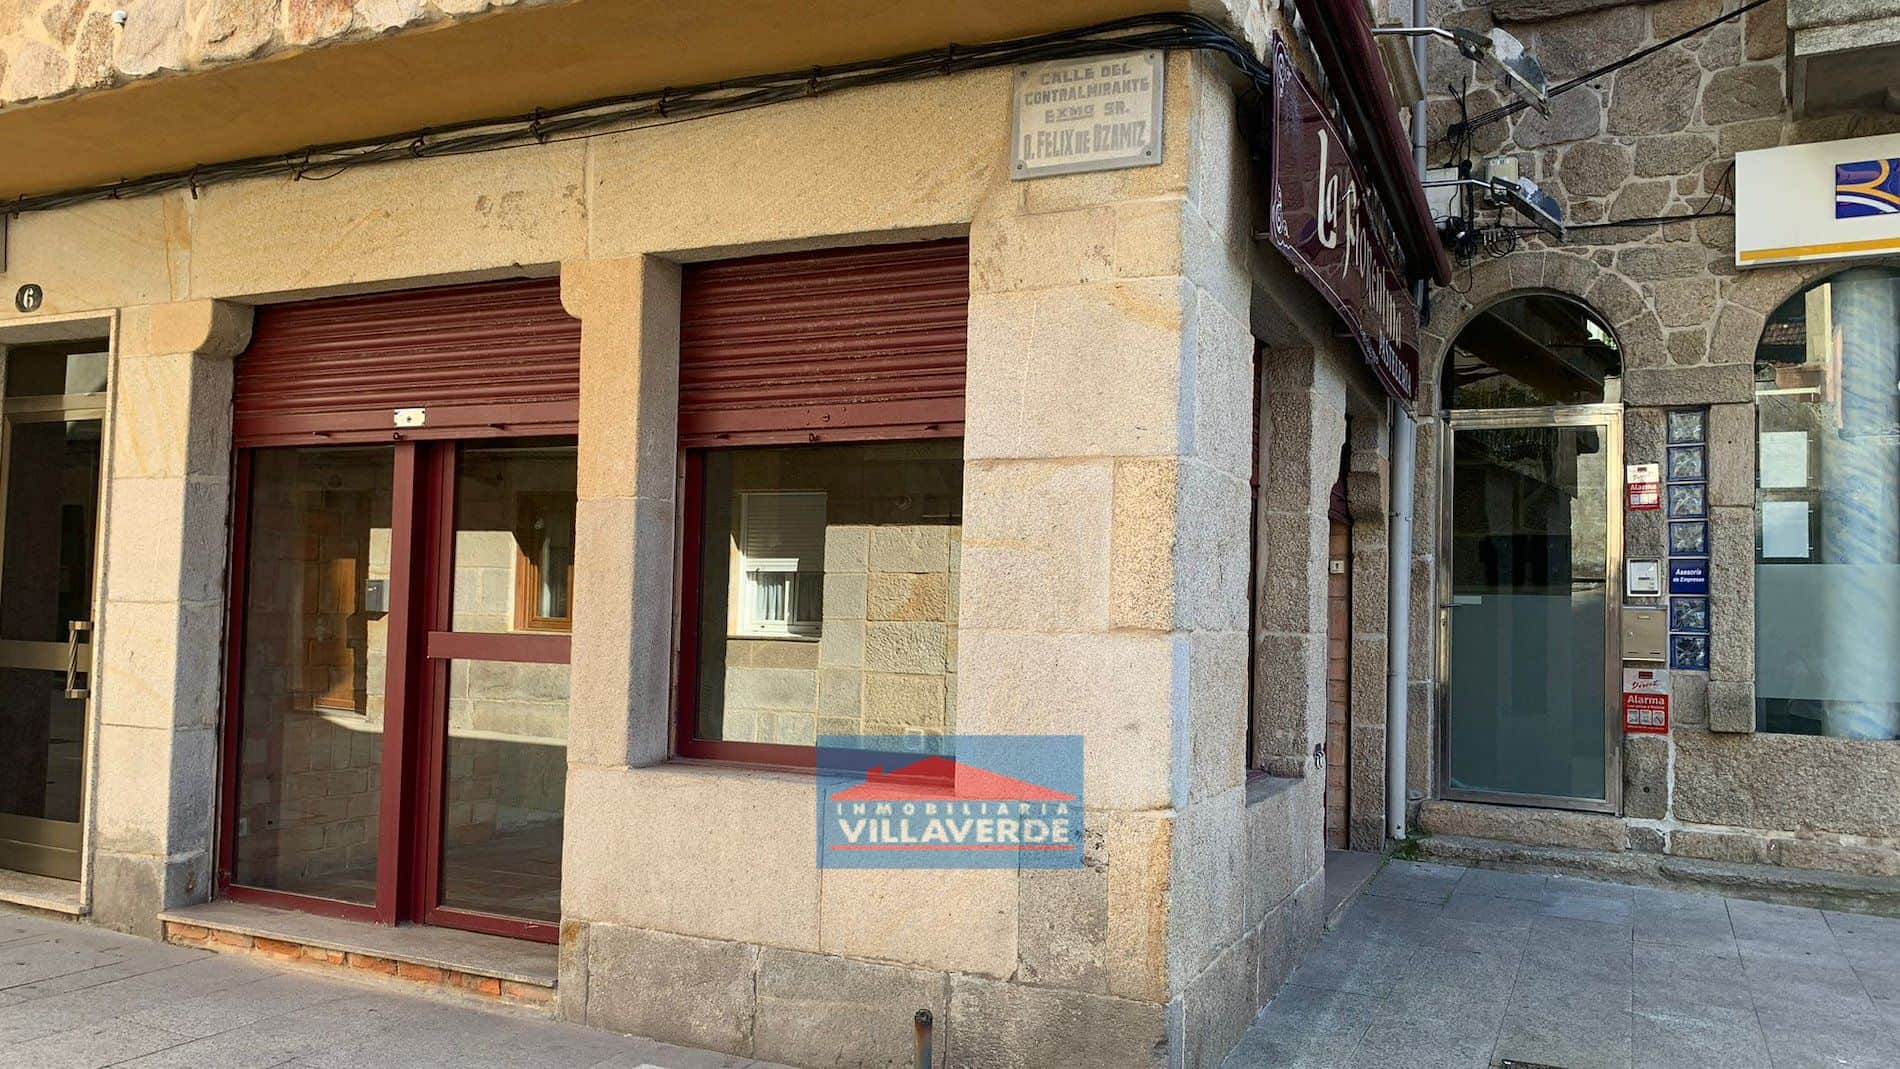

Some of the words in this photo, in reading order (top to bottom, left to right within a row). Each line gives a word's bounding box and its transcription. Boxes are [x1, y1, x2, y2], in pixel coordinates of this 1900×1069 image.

[1040, 66, 1094, 85] CALLE
[1101, 61, 1132, 76] DEL
[1024, 77, 1149, 106] CONTRALMIRANTE
[1104, 101, 1130, 116] SR.
[1075, 130, 1090, 154] DE
[23, 287, 34, 309] 6
[1627, 695, 1665, 705] Alarma
